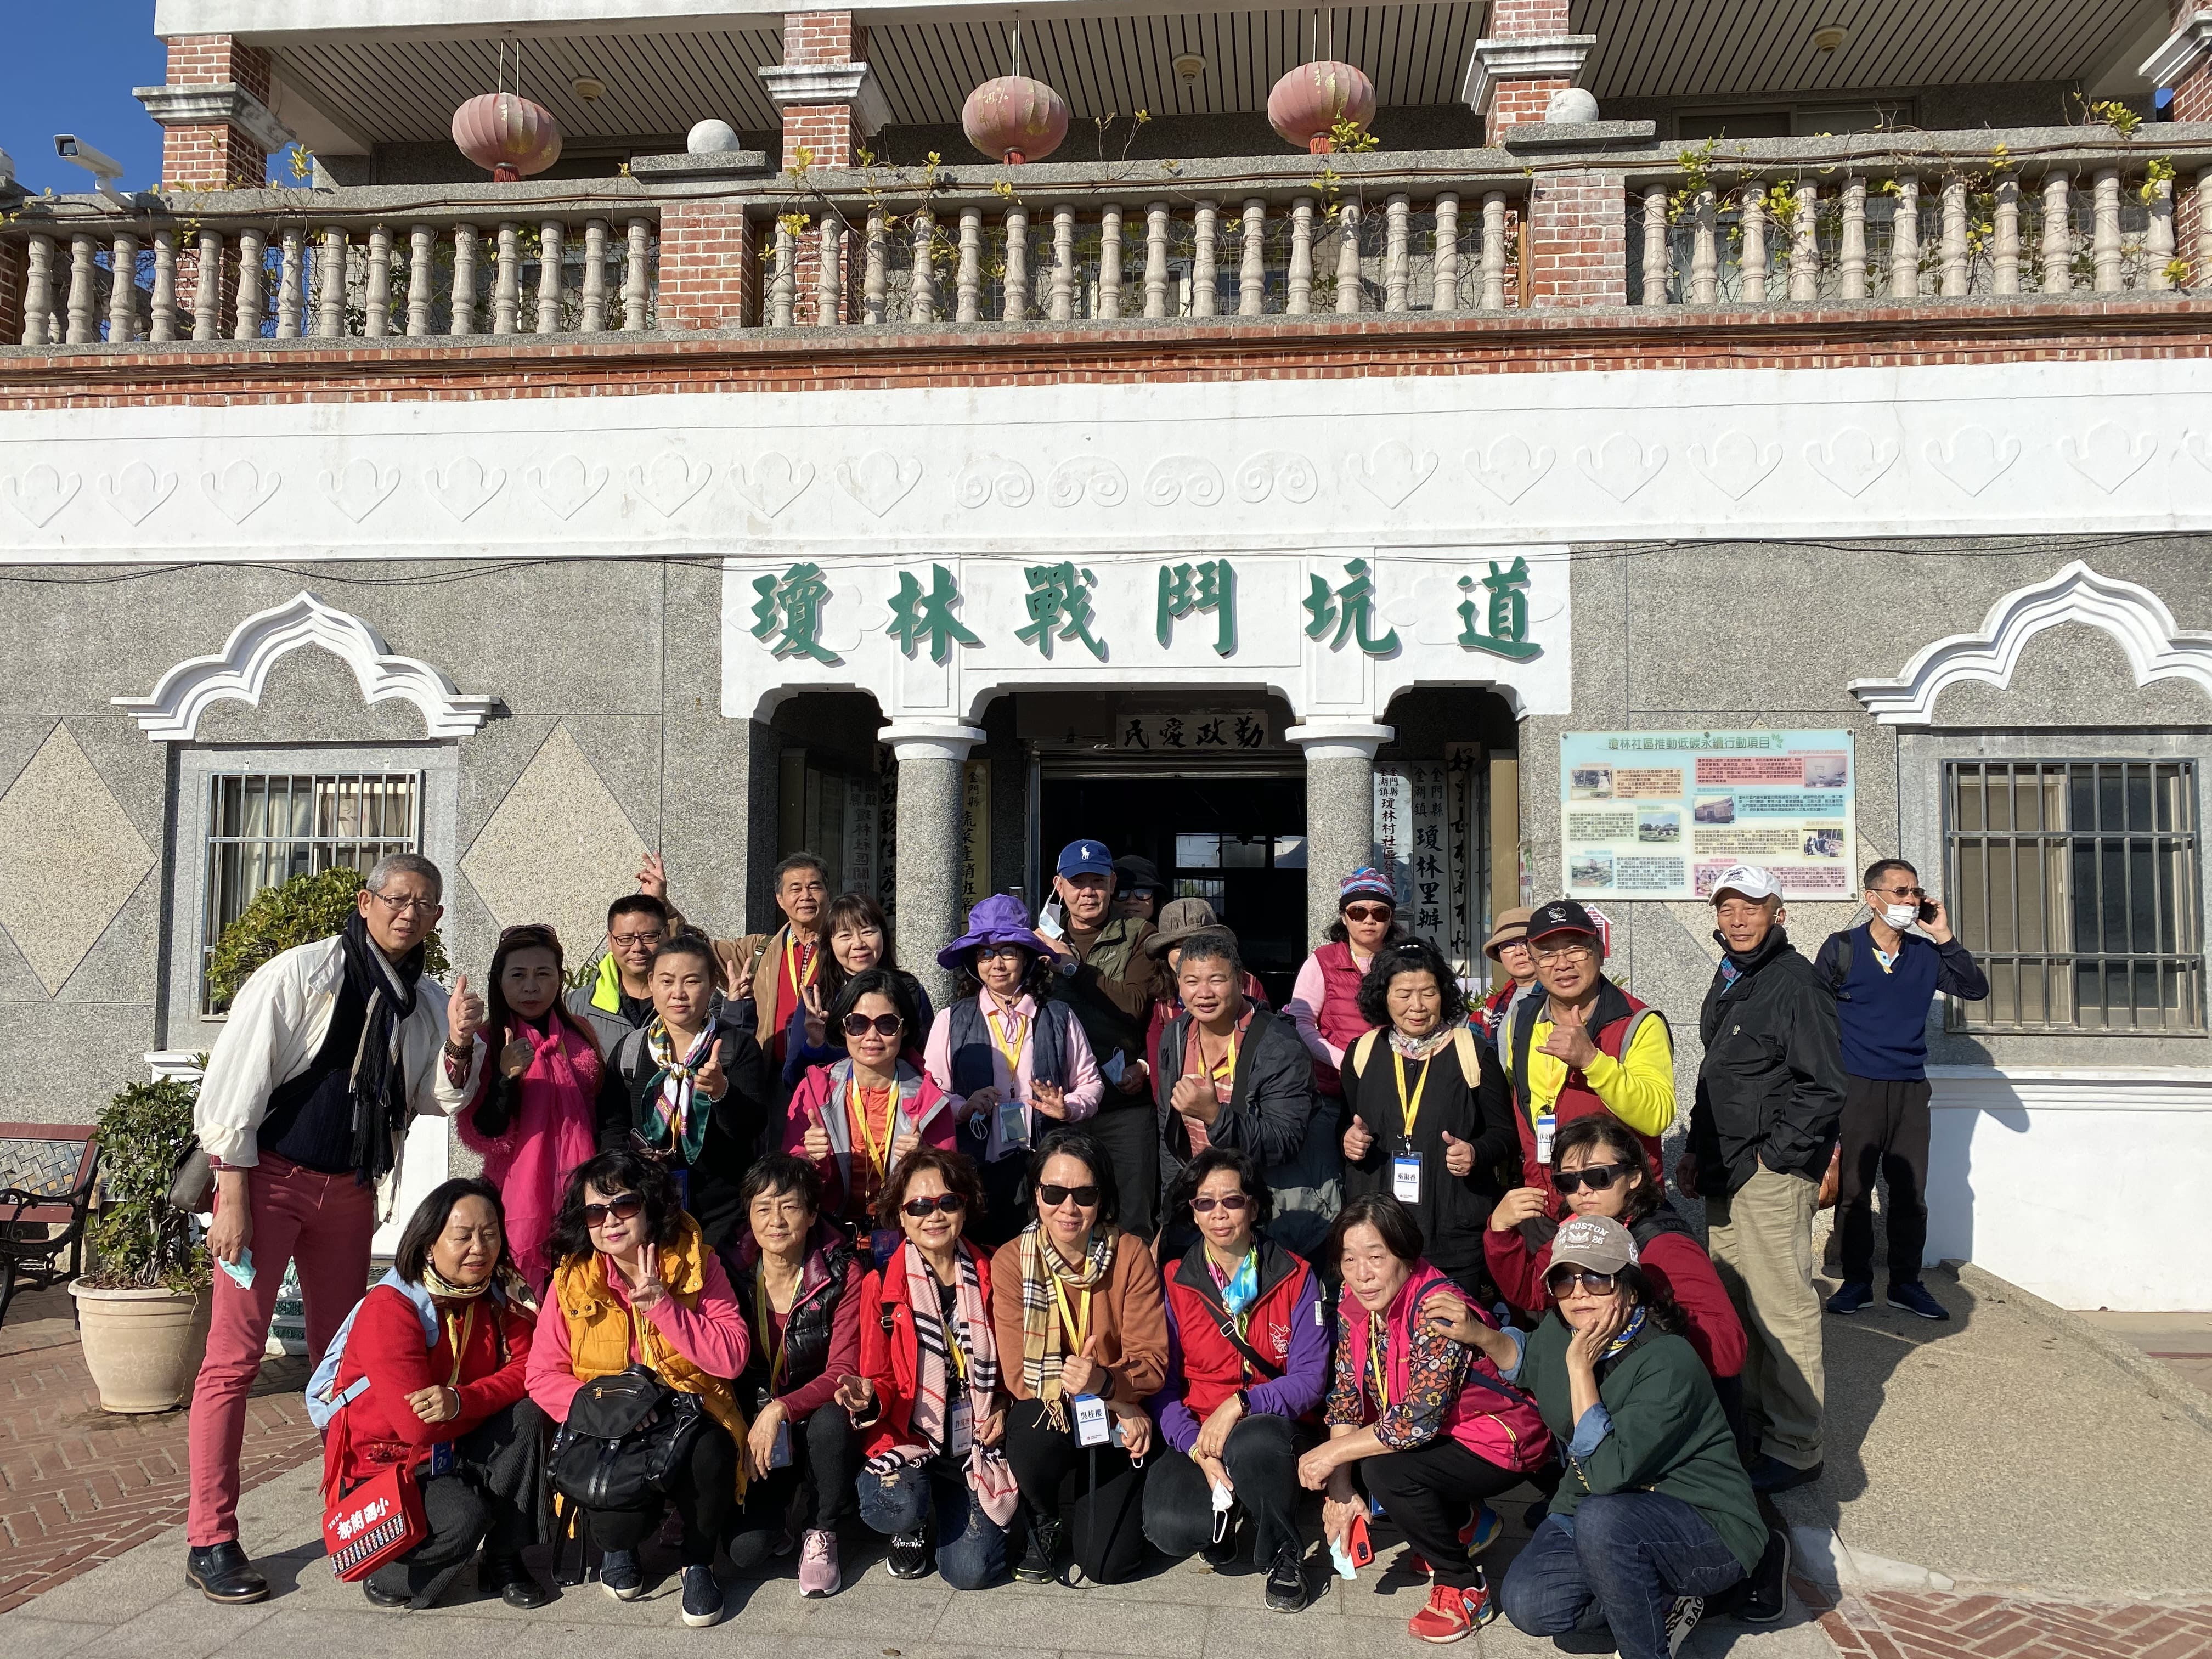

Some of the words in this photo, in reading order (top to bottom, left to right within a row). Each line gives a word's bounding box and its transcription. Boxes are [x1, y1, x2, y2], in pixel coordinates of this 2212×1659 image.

[750, 557, 1542, 663] 瓊林戰鬥坑道
[1608, 737, 1770, 749] 瓊林社區推動低碳永續行動項目
[967, 771, 980, 808] 金門縣
[1378, 768, 1389, 797] 金湖鎮
[1389, 768, 1400, 797] 金門縣
[1413, 768, 1429, 818] 金湖鎮
[1430, 768, 1444, 817] 金門縣
[1381, 798, 1398, 904] 瓊林村社區發展
[1415, 825, 1445, 952] 瓊林里辦
[1569, 1222, 1610, 1237] BOSTON
[1591, 1235, 1605, 1245] 25
[328, 1511, 343, 1530] 2020
[336, 1497, 390, 1541] 都蘭國小
